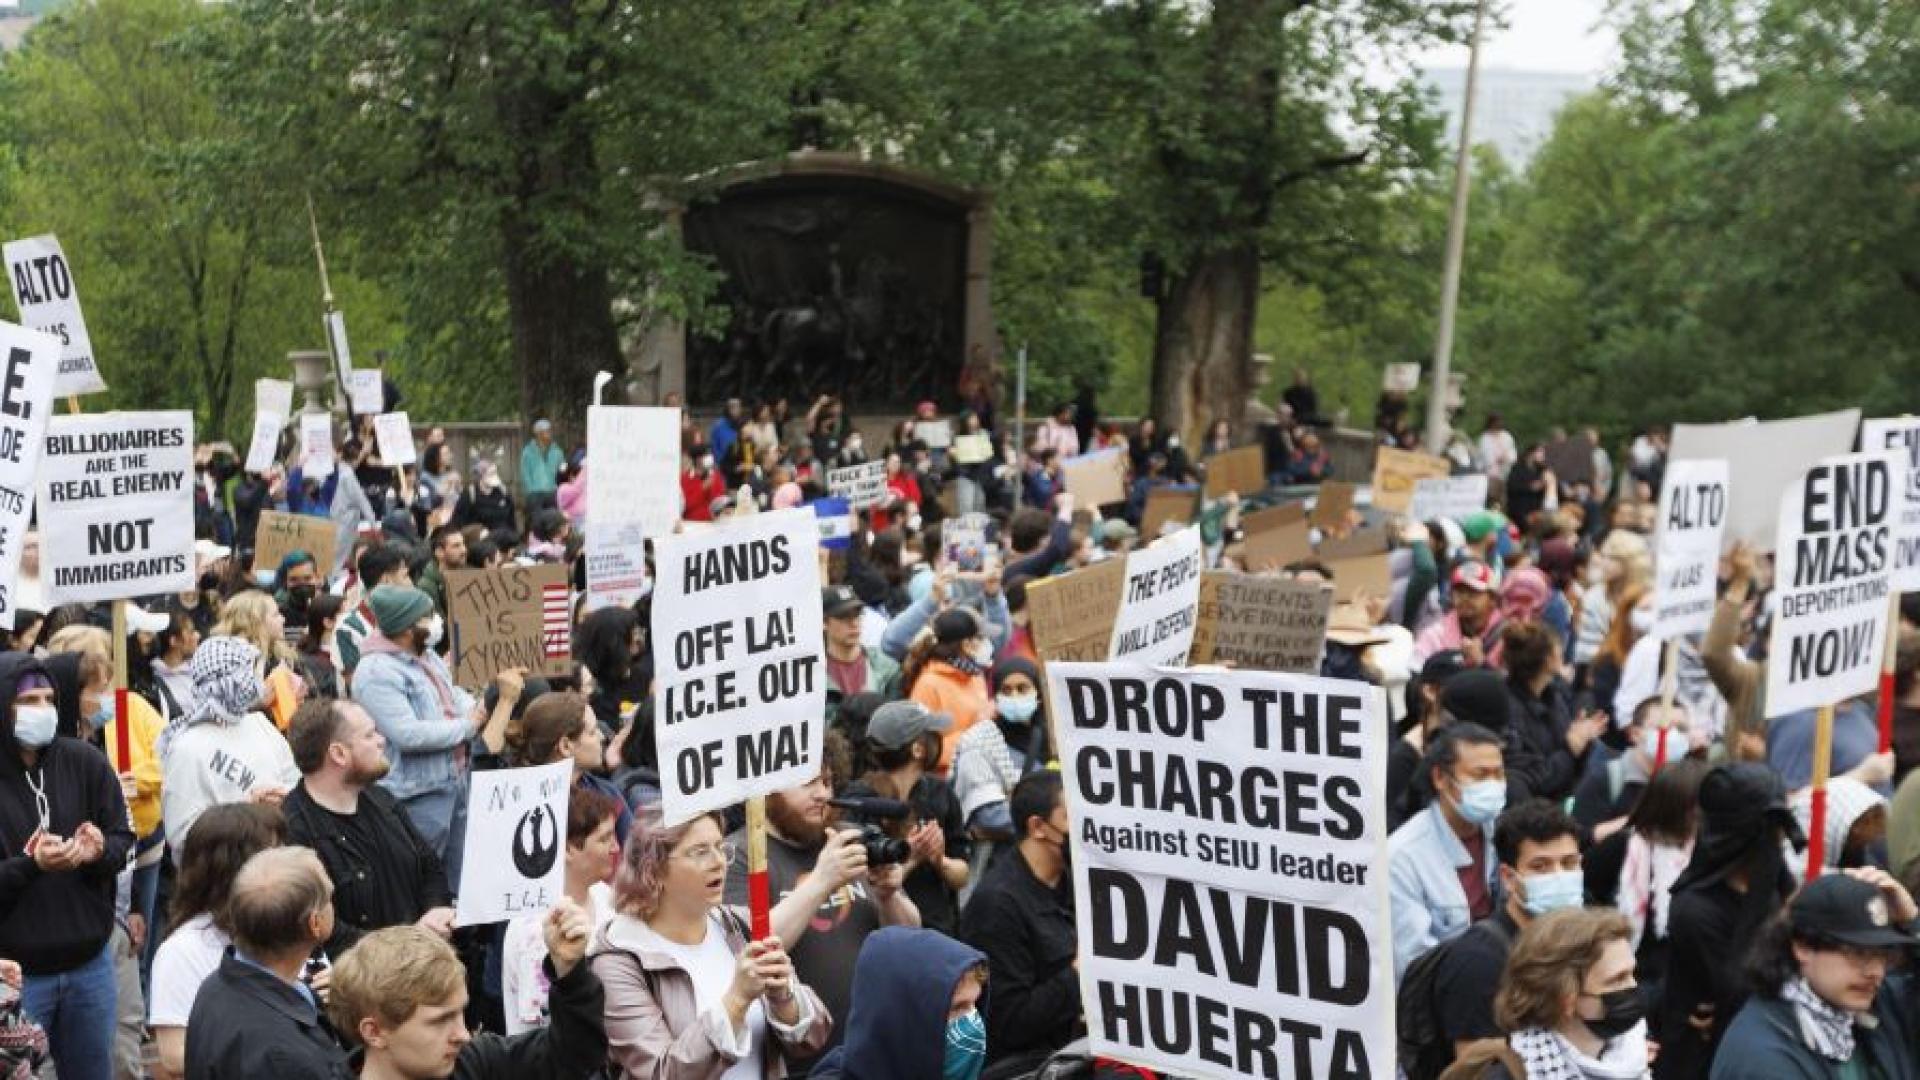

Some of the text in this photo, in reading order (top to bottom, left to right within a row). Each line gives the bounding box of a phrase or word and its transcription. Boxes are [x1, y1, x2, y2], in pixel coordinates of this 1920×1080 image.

[14, 254, 70, 306] ALTO
[46, 428, 185, 456] BILLIONAIRES
[85, 454, 149, 474] ARE THE
[50, 471, 184, 502] REAL ENEMY
[1668, 483, 1725, 530] ALTO
[1803, 460, 1889, 534] END
[88, 518, 154, 556] NOT
[683, 534, 791, 594] HANDS
[1793, 527, 1888, 588] MASS
[55, 555, 185, 587] IMMIGRANTS
[456, 567, 532, 615] THIS
[1128, 569, 1158, 604] THE
[484, 610, 516, 635] IS
[1782, 581, 1888, 619] DEPORTATIONS
[675, 606, 796, 671] OFF LA!
[1788, 618, 1876, 685] NOW!
[665, 654, 820, 725] I.C.E. OUT
[1066, 678, 1362, 760] DROP THE
[209, 749, 256, 792] NEW
[676, 720, 809, 795] OF MA!
[1075, 745, 1364, 841] CHARGES
[1082, 817, 1368, 886] Against SEIU leader
[1088, 866, 1370, 1006] DAVID
[1097, 979, 1372, 1080] HUERTA
